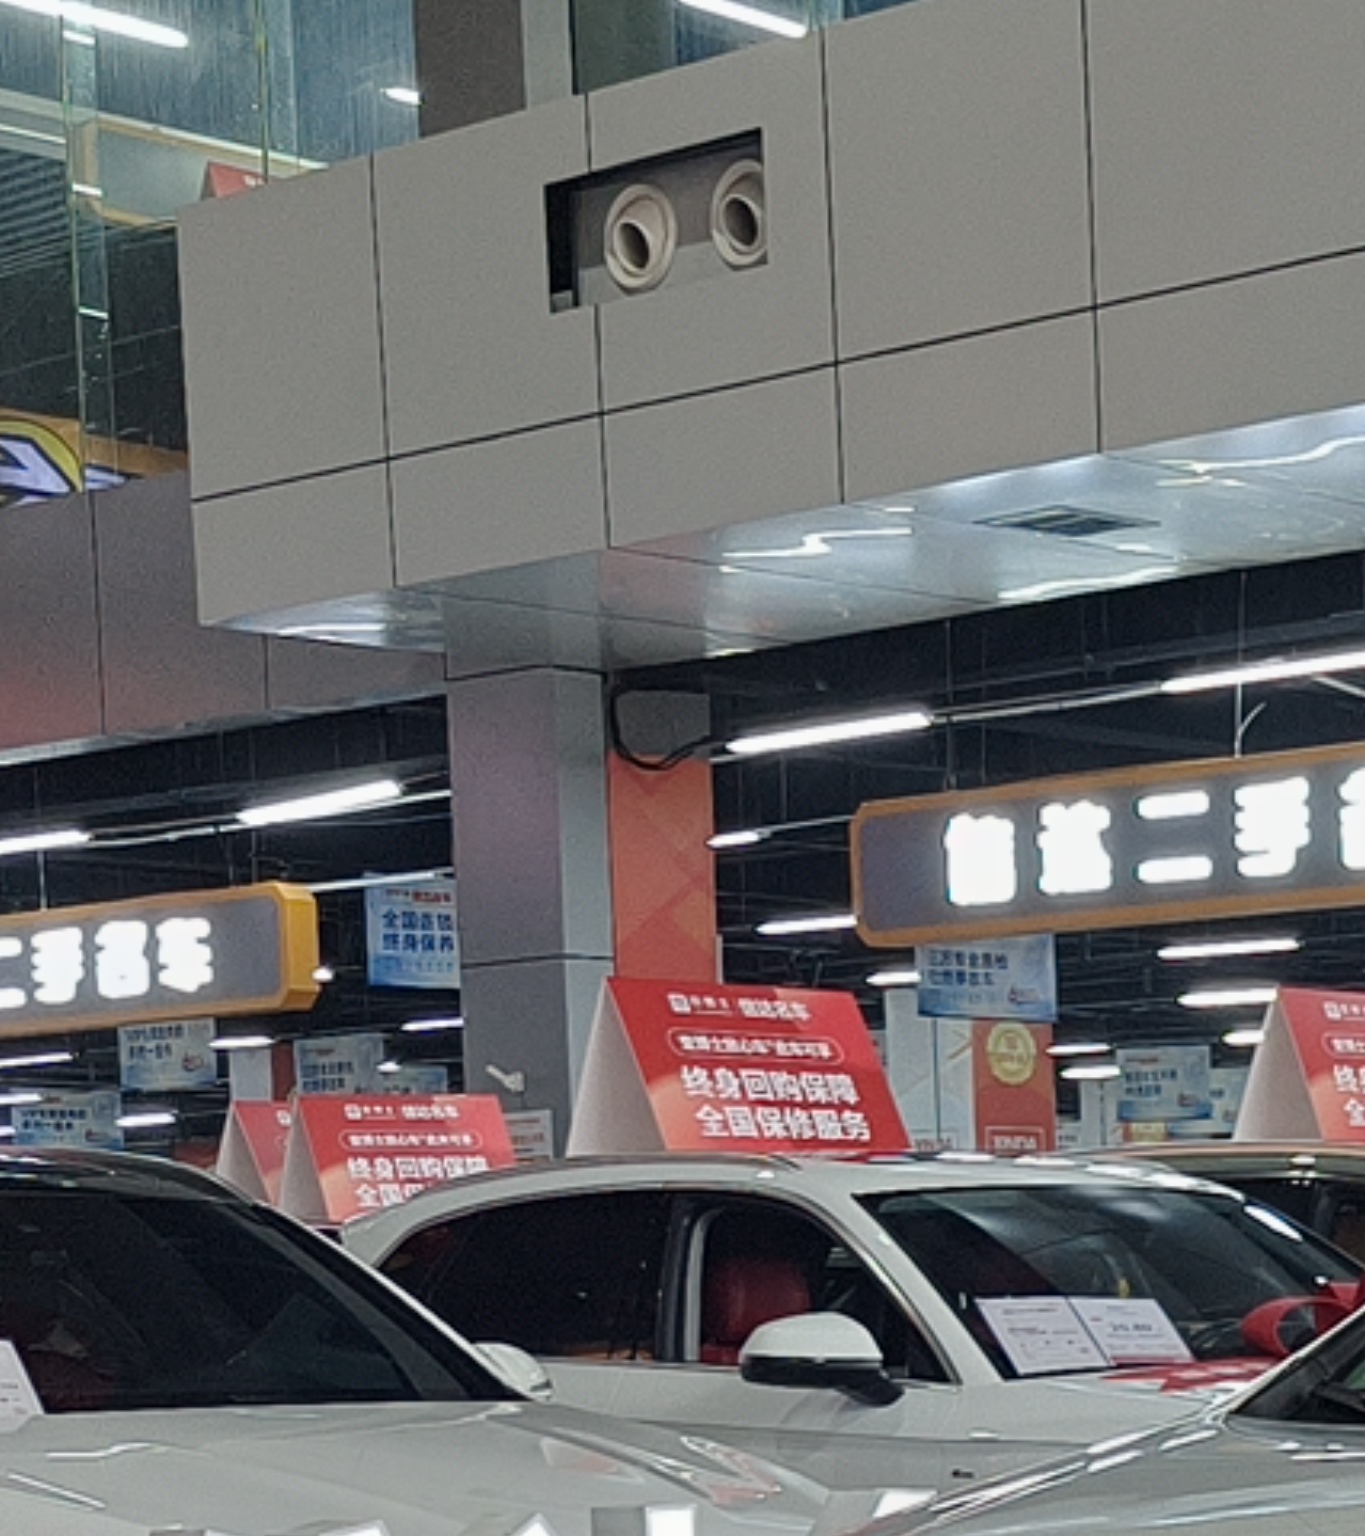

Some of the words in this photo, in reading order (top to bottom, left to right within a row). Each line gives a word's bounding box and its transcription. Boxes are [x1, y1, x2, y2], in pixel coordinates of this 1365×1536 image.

[680, 1065, 860, 1106] 终身回购保障
[695, 1104, 871, 1142] 全国保修服务
